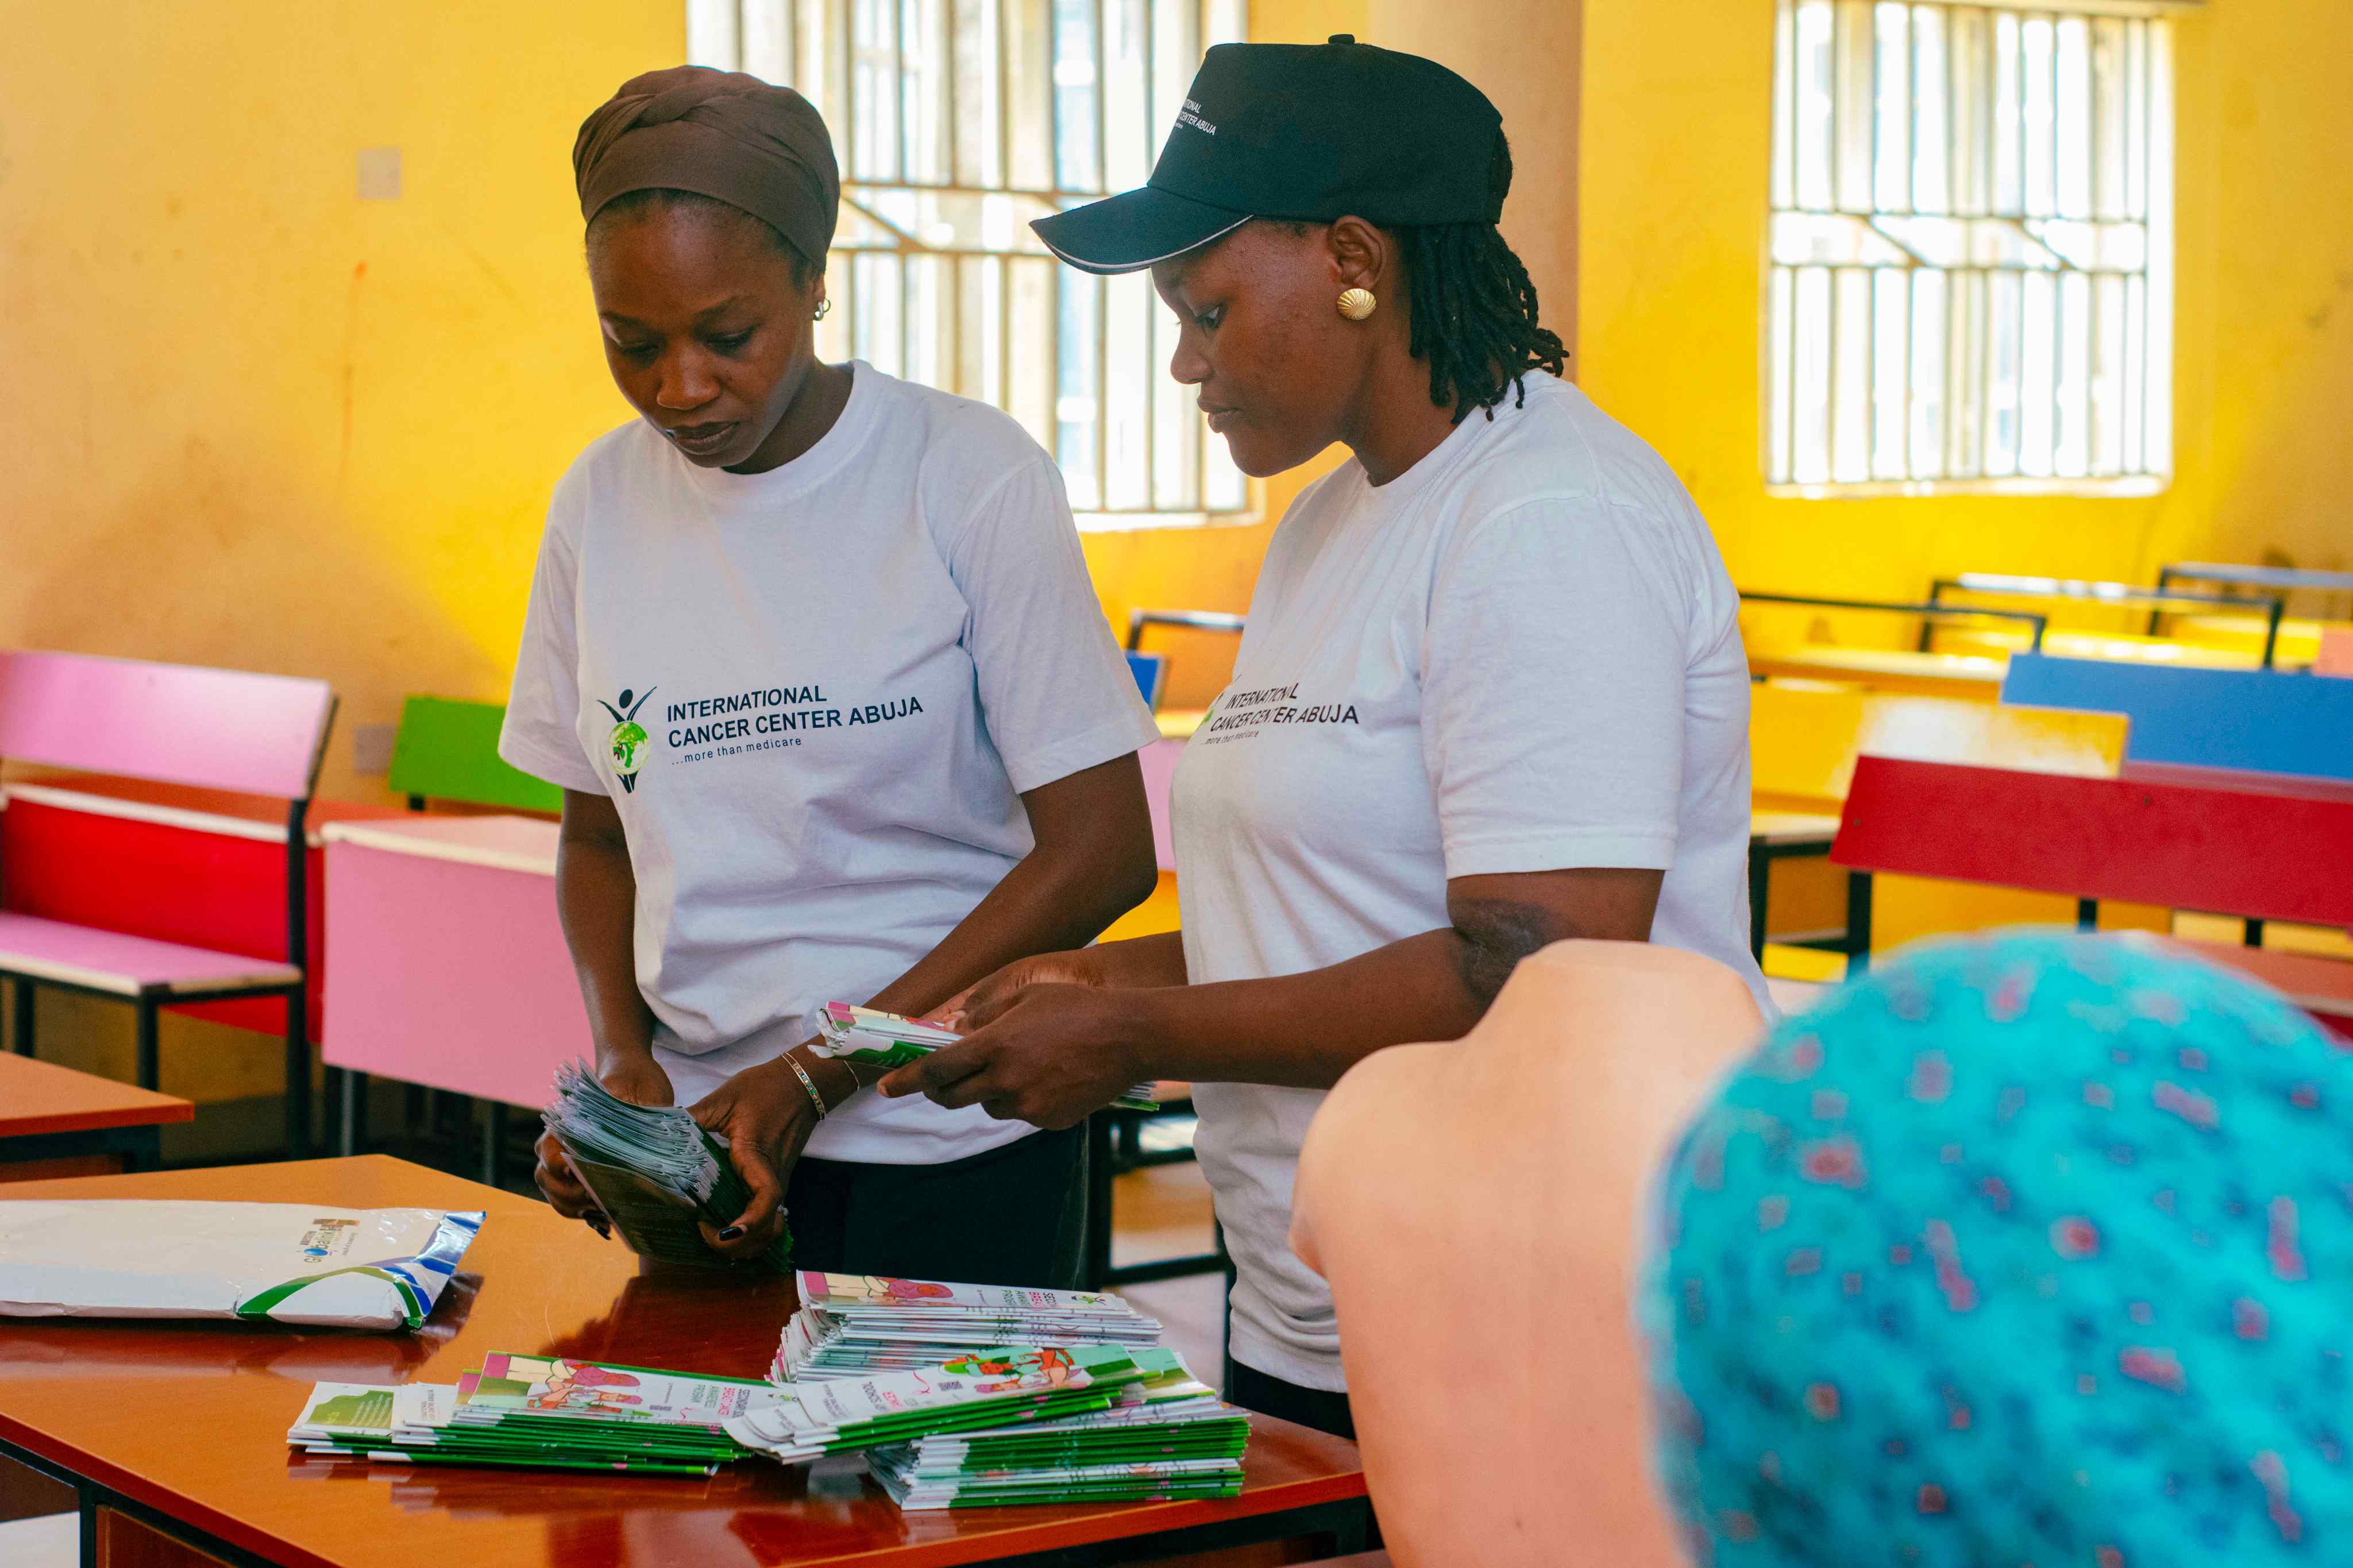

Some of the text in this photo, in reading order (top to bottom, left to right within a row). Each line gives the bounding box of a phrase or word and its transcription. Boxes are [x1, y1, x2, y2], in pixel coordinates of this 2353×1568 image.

[1195, 119, 1216, 136] ABUJA
[668, 685, 827, 722] INTERNATIONAL
[669, 697, 924, 748] CANCER CENTER ABUJA
[1210, 712, 1253, 732] CANCER
[1295, 704, 1359, 724] ABUJA
[718, 746, 742, 756] than
[746, 737, 801, 752] medicare
